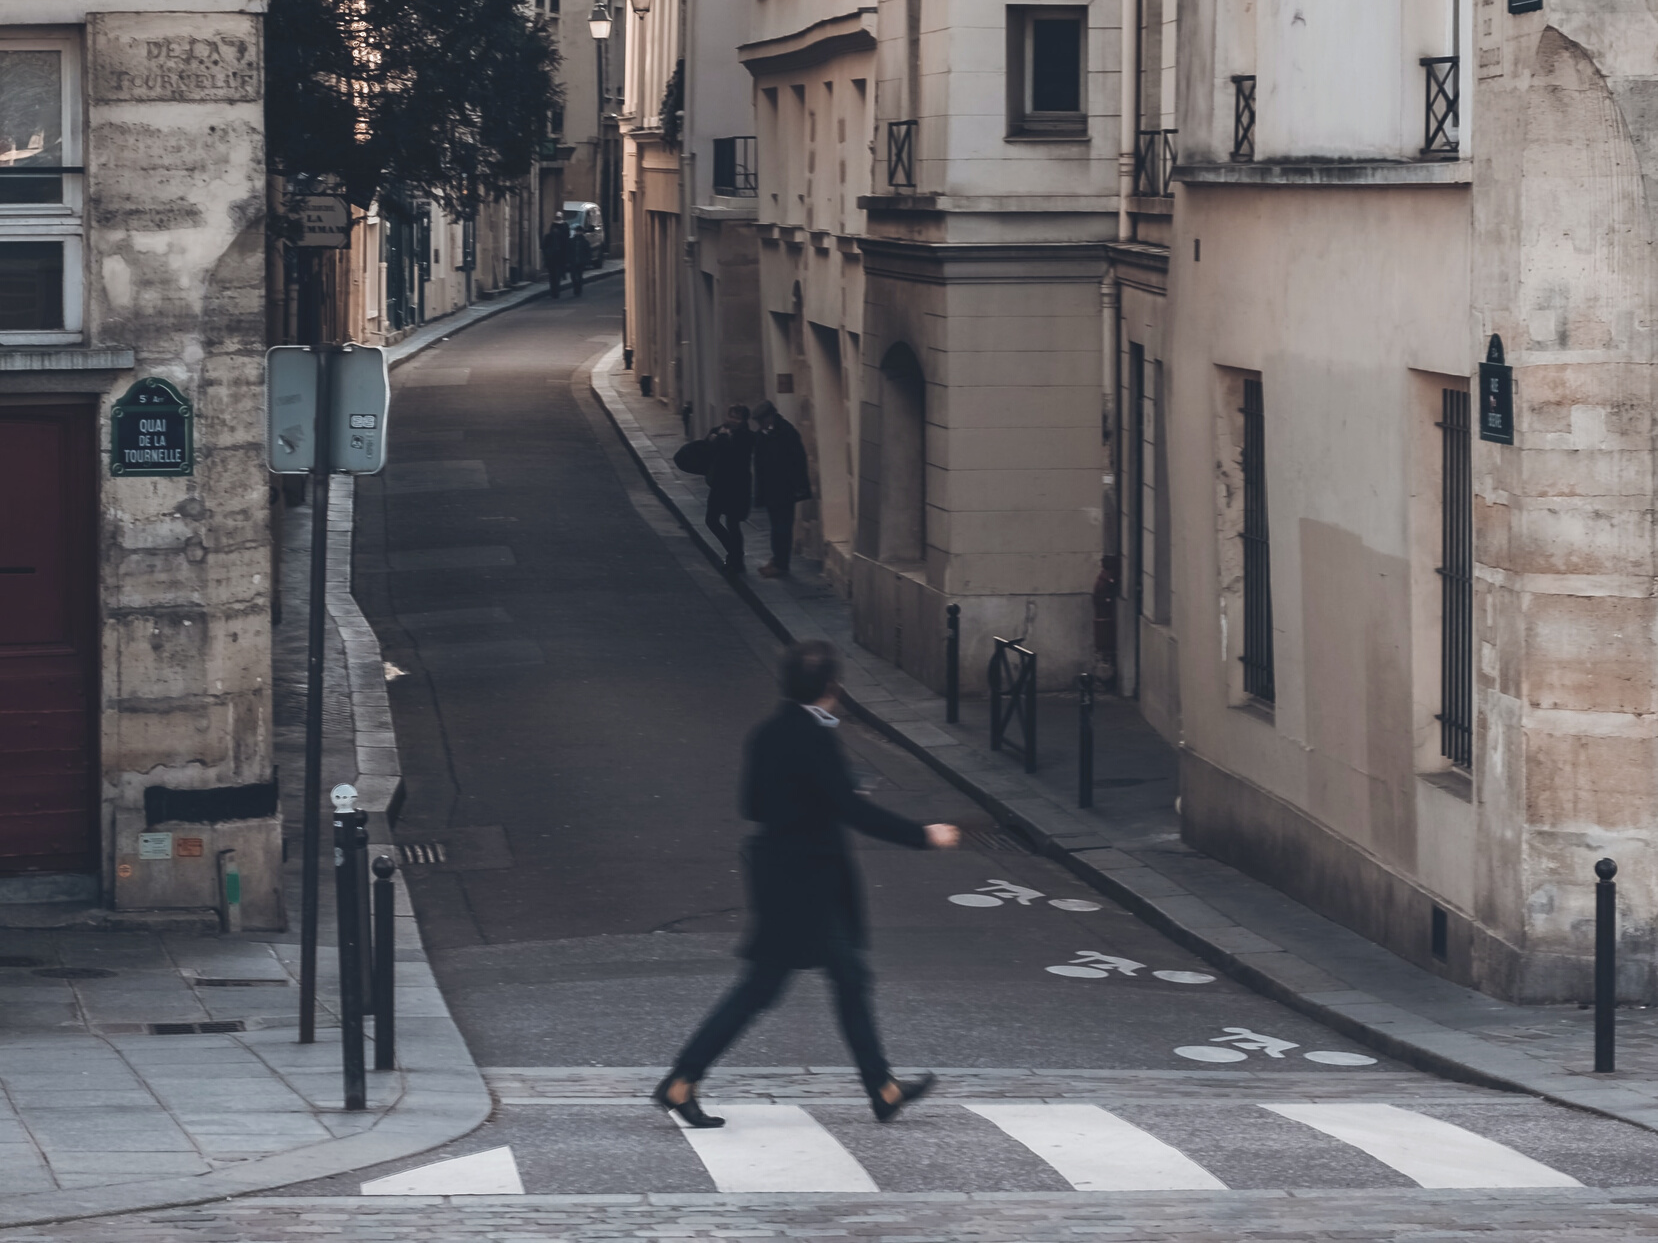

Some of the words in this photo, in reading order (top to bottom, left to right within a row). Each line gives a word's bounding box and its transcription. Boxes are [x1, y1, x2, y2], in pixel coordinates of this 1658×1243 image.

[139, 419, 167, 433] QUAI
[138, 435, 151, 447] DE
[154, 435, 167, 447] LA
[124, 448, 182, 463] TOURNELLE
